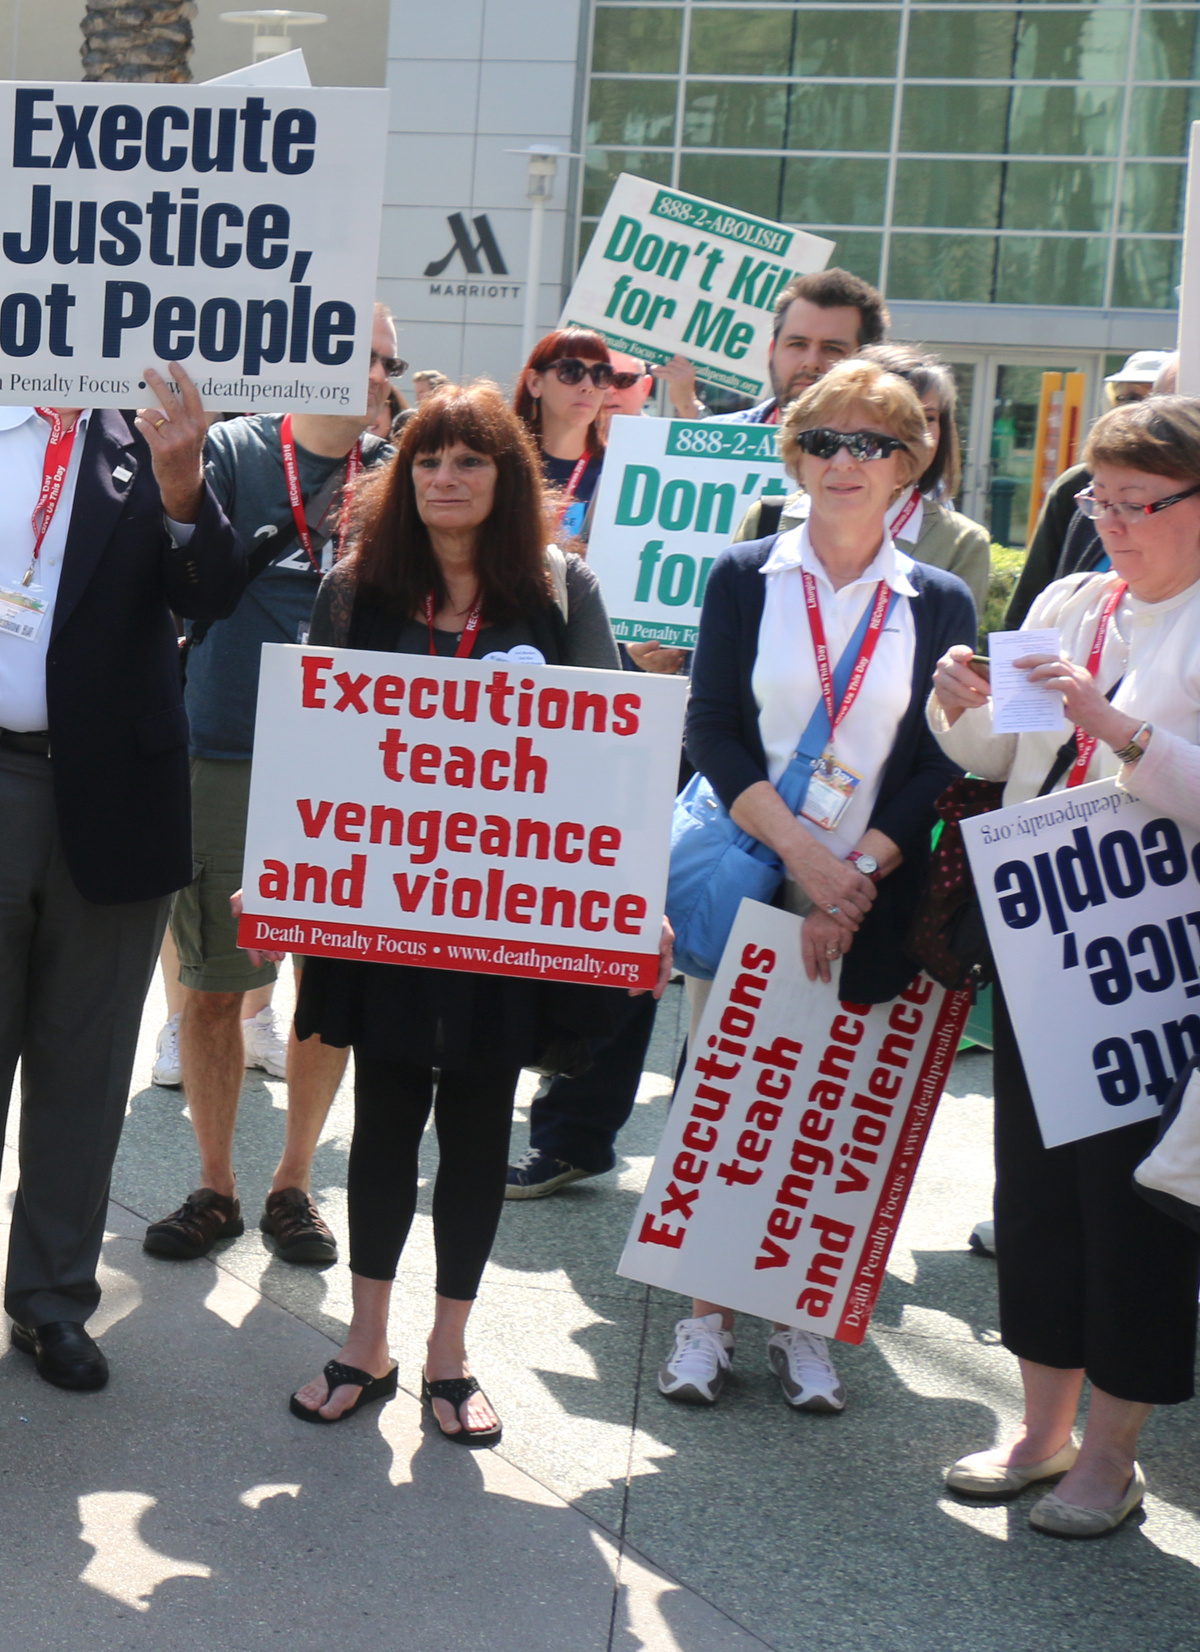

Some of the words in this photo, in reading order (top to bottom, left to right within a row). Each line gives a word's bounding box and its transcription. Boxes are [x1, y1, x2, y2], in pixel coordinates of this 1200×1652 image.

[12, 88, 317, 175] Execute
[2, 184, 314, 283] Justice,
[603, 214, 724, 292] Don't
[657, 197, 787, 253] 888-2-ABOLISH
[429, 284, 521, 298] MARRIOTT
[604, 274, 678, 332] for
[682, 298, 755, 360] Me
[102, 280, 356, 376] People
[10, 373, 73, 398] Penalty
[78, 375, 130, 395] Focus
[42, 475, 52, 492] Day
[46, 501, 55, 514] Us
[49, 483, 60, 501] This
[54, 465, 66, 482] Day
[286, 461, 300, 507] RECongress
[632, 623, 681, 645] Penalty
[817, 644, 827, 662] Day
[300, 655, 642, 737] Executions
[848, 674, 862, 691] This
[855, 656, 869, 673] Day
[378, 728, 548, 794] teach
[296, 798, 622, 867] vengeance
[258, 854, 367, 909] and
[393, 868, 648, 936] violence
[993, 817, 1200, 935] eople
[255, 921, 304, 943] Death
[310, 927, 373, 954] Penalty
[376, 934, 427, 957] Focus
[447, 945, 640, 983] www.deathpenalty.org
[1063, 911, 1200, 1006] ice,
[638, 942, 777, 1250] Executions
[716, 1036, 804, 1186] teach
[796, 1214, 856, 1318] and
[834, 974, 935, 1194] violence
[845, 1276, 871, 1328] Death
[860, 1221, 894, 1278] Penalty
[878, 1174, 906, 1219] Focus
